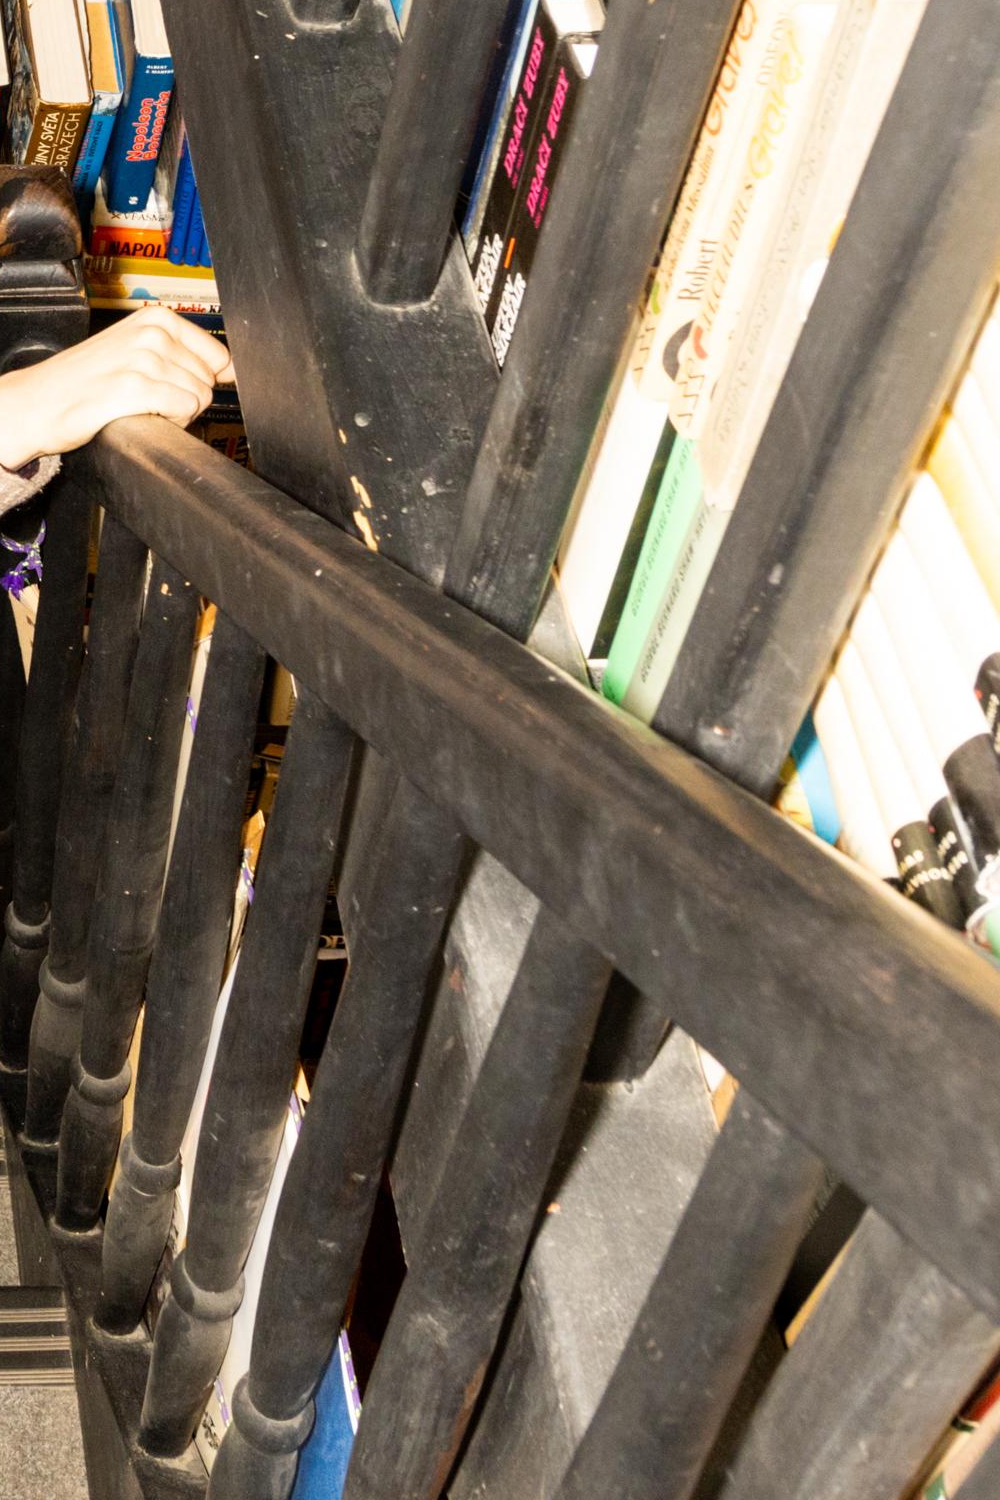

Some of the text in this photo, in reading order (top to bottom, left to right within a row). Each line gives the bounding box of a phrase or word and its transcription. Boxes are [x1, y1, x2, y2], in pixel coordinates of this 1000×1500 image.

[40, 110, 61, 141] SVĚTA
[55, 112, 82, 170] BRAZECH
[125, 98, 154, 162] Napoleon
[142, 89, 172, 161] Bonaparte
[108, 242, 167, 258] NAPOL
[677, 237, 720, 303] Robert
